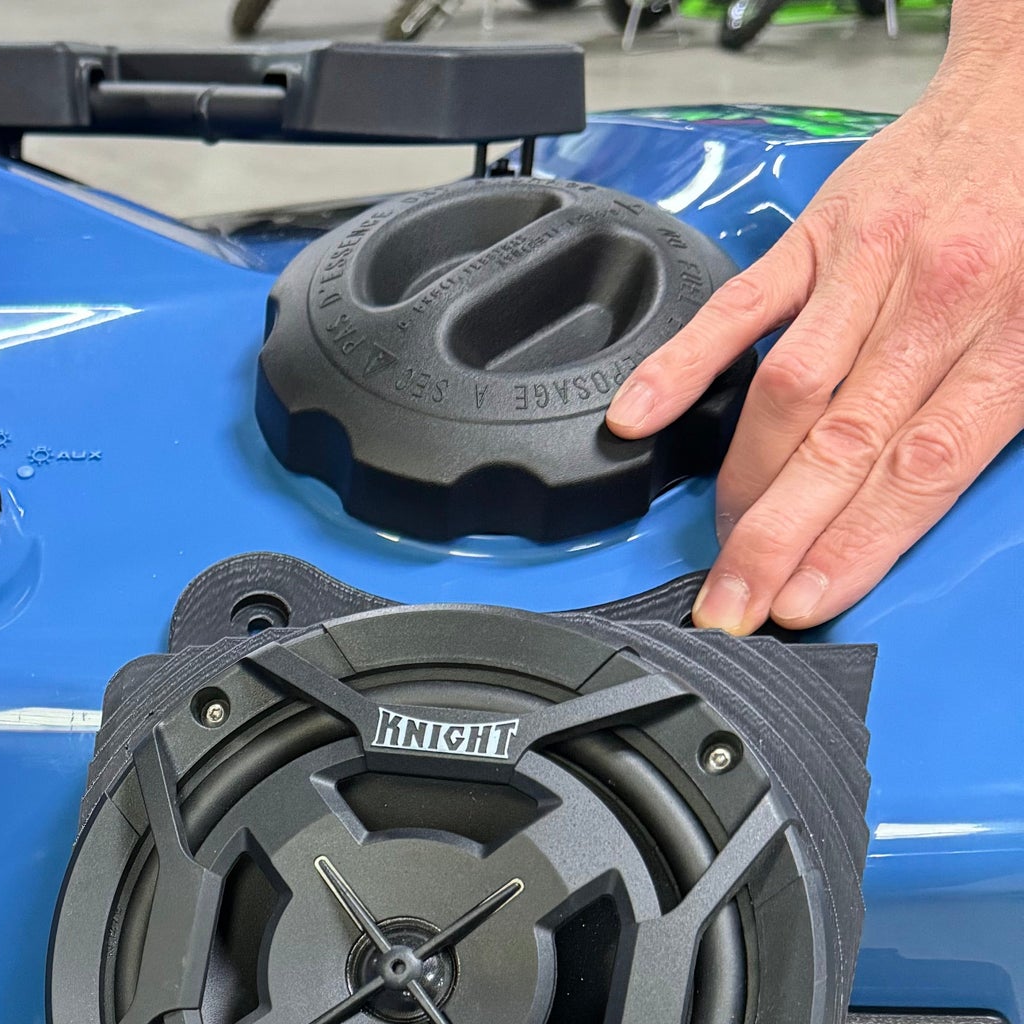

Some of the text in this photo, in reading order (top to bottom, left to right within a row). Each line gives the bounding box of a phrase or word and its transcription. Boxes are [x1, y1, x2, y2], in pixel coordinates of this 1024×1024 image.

[325, 313, 366, 356] PAS
[395, 368, 449, 403] SEC
[56, 449, 102, 461] AUX
[374, 708, 518, 757] KNIGHT
